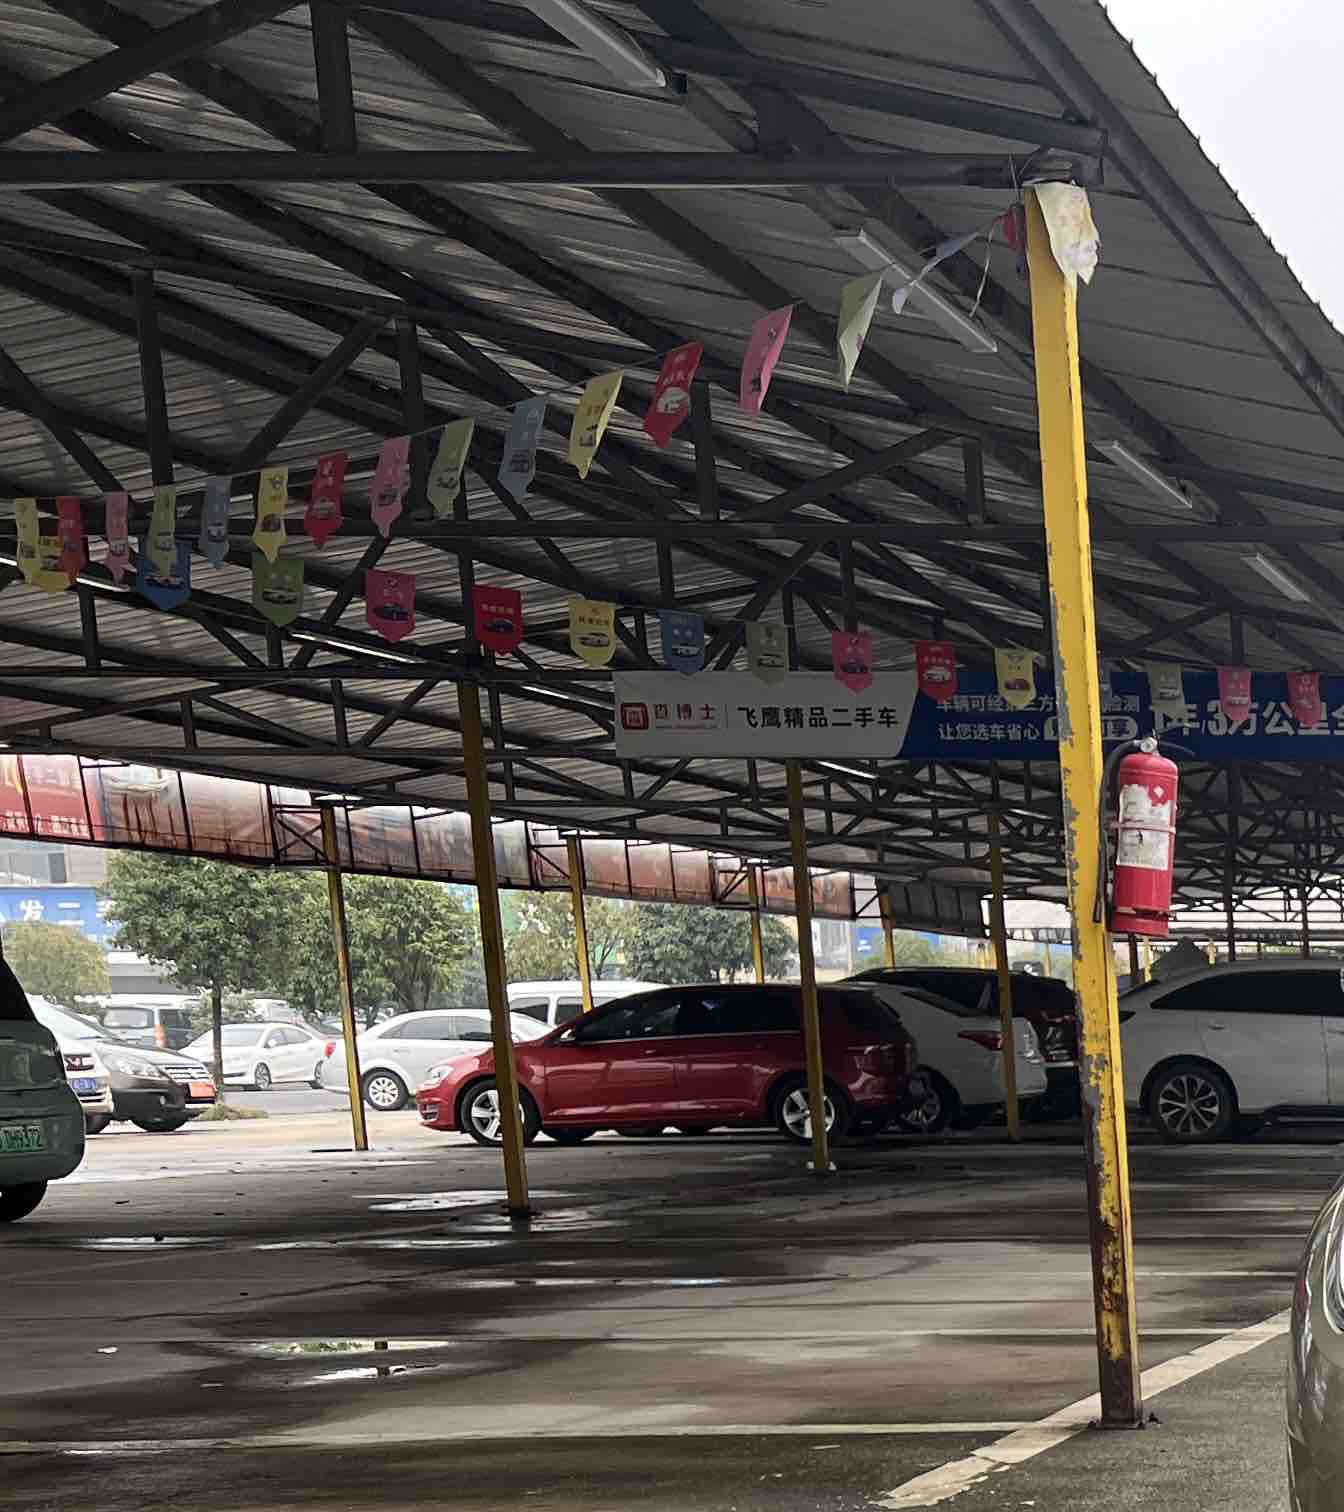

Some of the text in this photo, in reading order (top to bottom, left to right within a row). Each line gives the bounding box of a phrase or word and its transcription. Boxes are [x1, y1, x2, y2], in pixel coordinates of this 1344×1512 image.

[737, 705, 899, 729] 飞鹰精品二手车
[937, 721, 1041, 742] 让您选车省心
